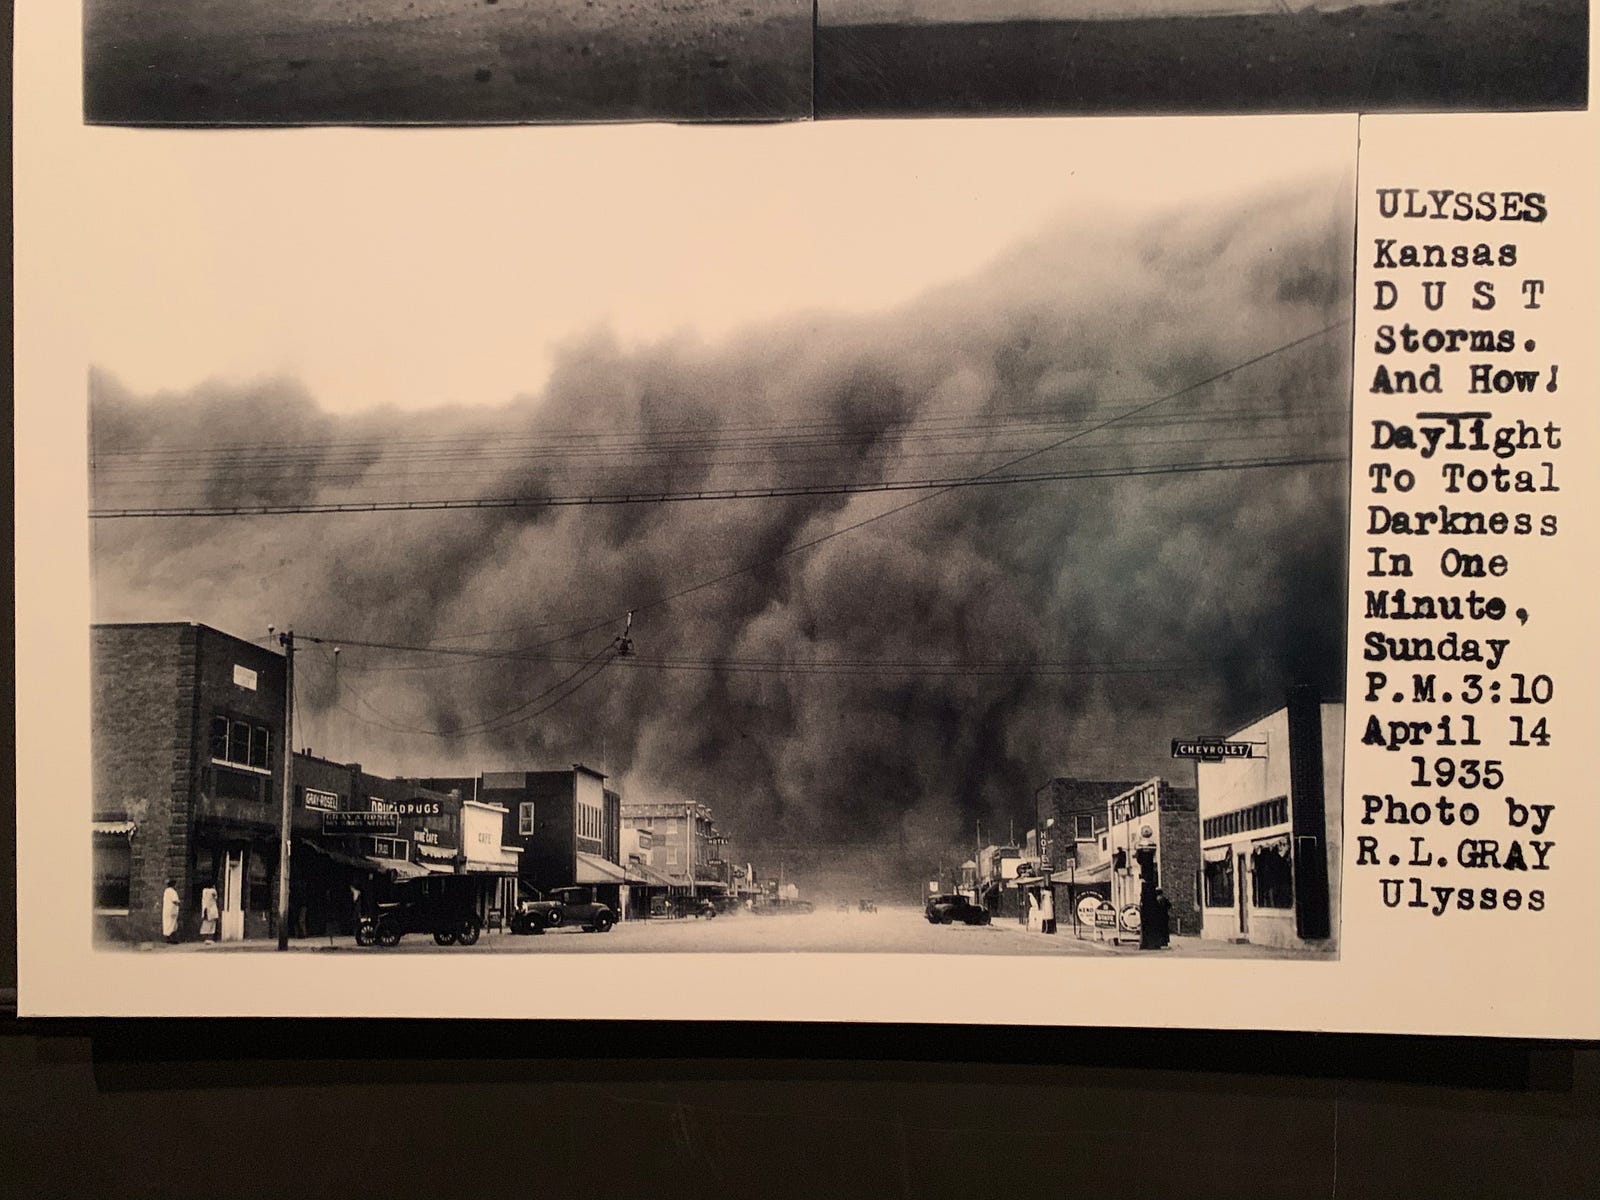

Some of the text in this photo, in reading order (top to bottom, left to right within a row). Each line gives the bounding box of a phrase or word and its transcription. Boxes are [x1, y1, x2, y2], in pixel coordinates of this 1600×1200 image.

[1376, 188, 1548, 223] ULYSSES
[1373, 238, 1518, 269] Kansas
[1374, 323, 1537, 355] Storms.
[1369, 363, 1560, 395] And How!
[1370, 411, 1562, 459] Daylight
[1368, 461, 1560, 494] To Total
[1366, 505, 1559, 537] Darkness
[1366, 546, 1509, 578] In One
[1364, 588, 1530, 626] Minute,
[1363, 630, 1511, 671] Sunday
[1180, 745, 1244, 755] CHEVROLET
[1360, 714, 1552, 752] April 14
[1410, 755, 1505, 790] 1935
[399, 803, 440, 814] DRUGS
[1360, 794, 1556, 836] Photo by
[1378, 877, 1545, 917] Ulysses
